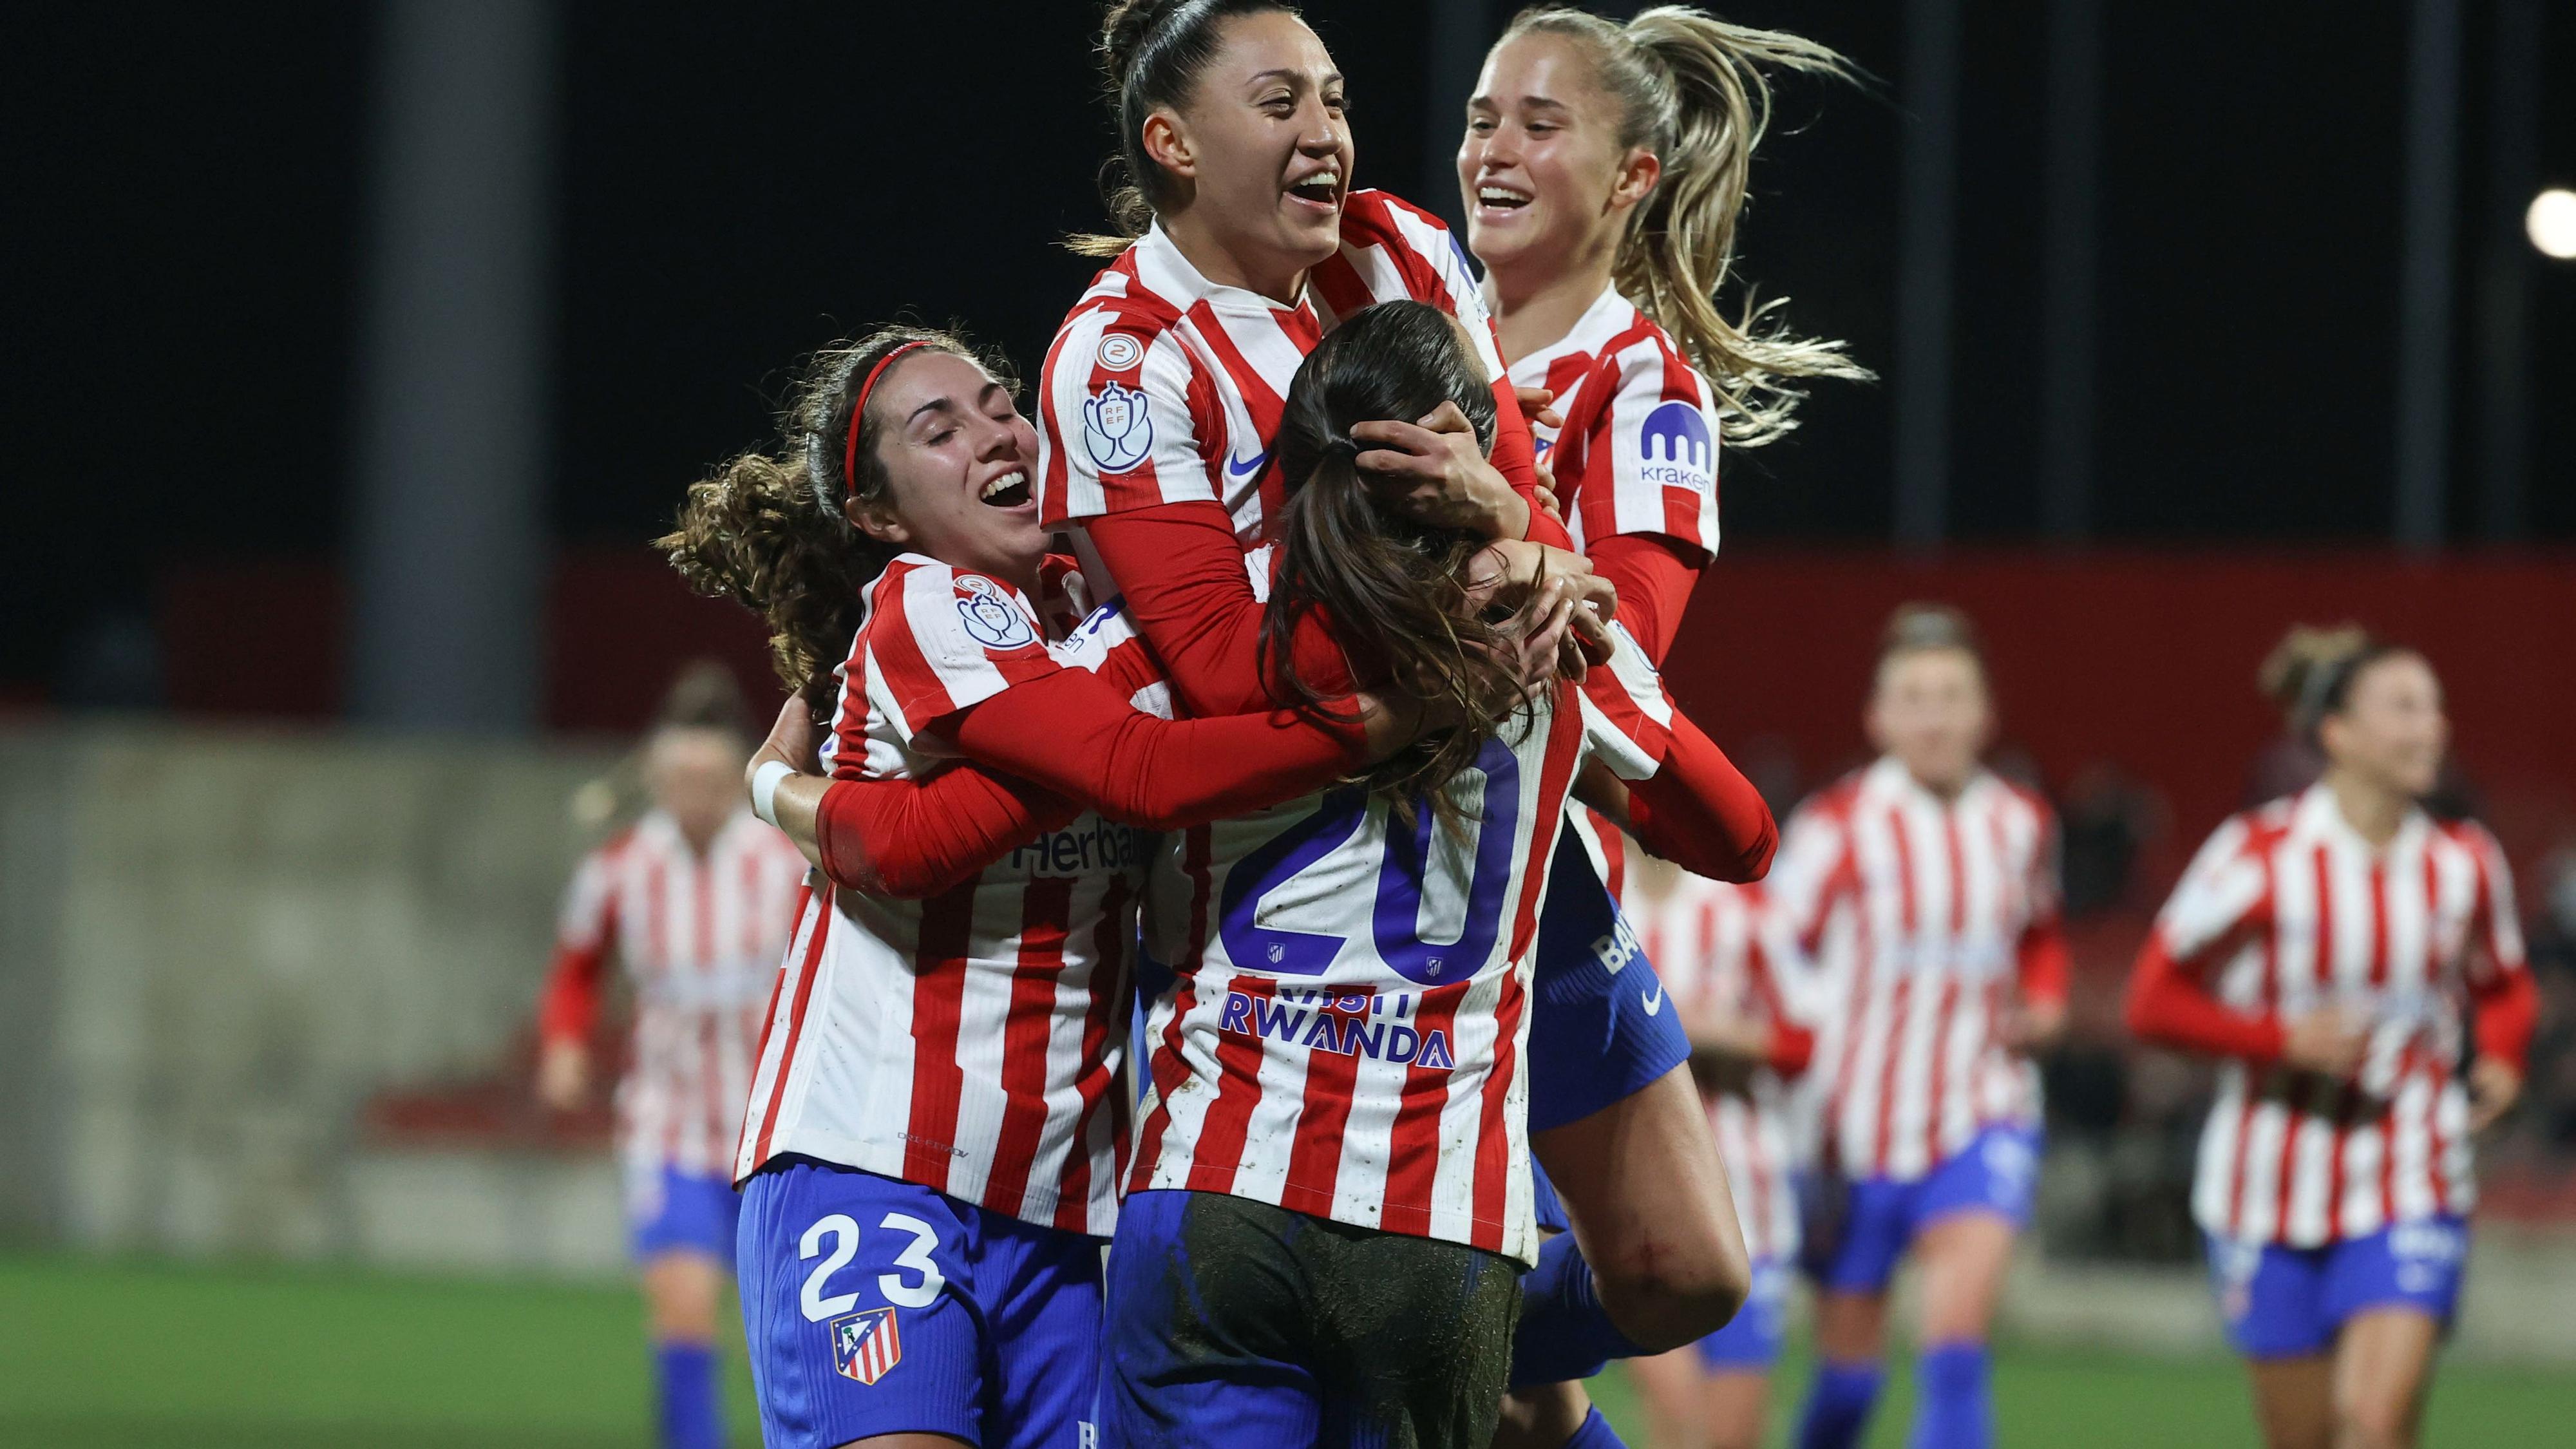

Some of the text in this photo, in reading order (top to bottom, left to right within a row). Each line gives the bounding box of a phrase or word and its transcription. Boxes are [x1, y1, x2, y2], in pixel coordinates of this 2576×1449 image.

[1641, 466, 1711, 497] kraken
[1219, 736, 1520, 986] 20
[1219, 992, 1455, 1070] RWANDA
[799, 1212, 945, 1323] 23
